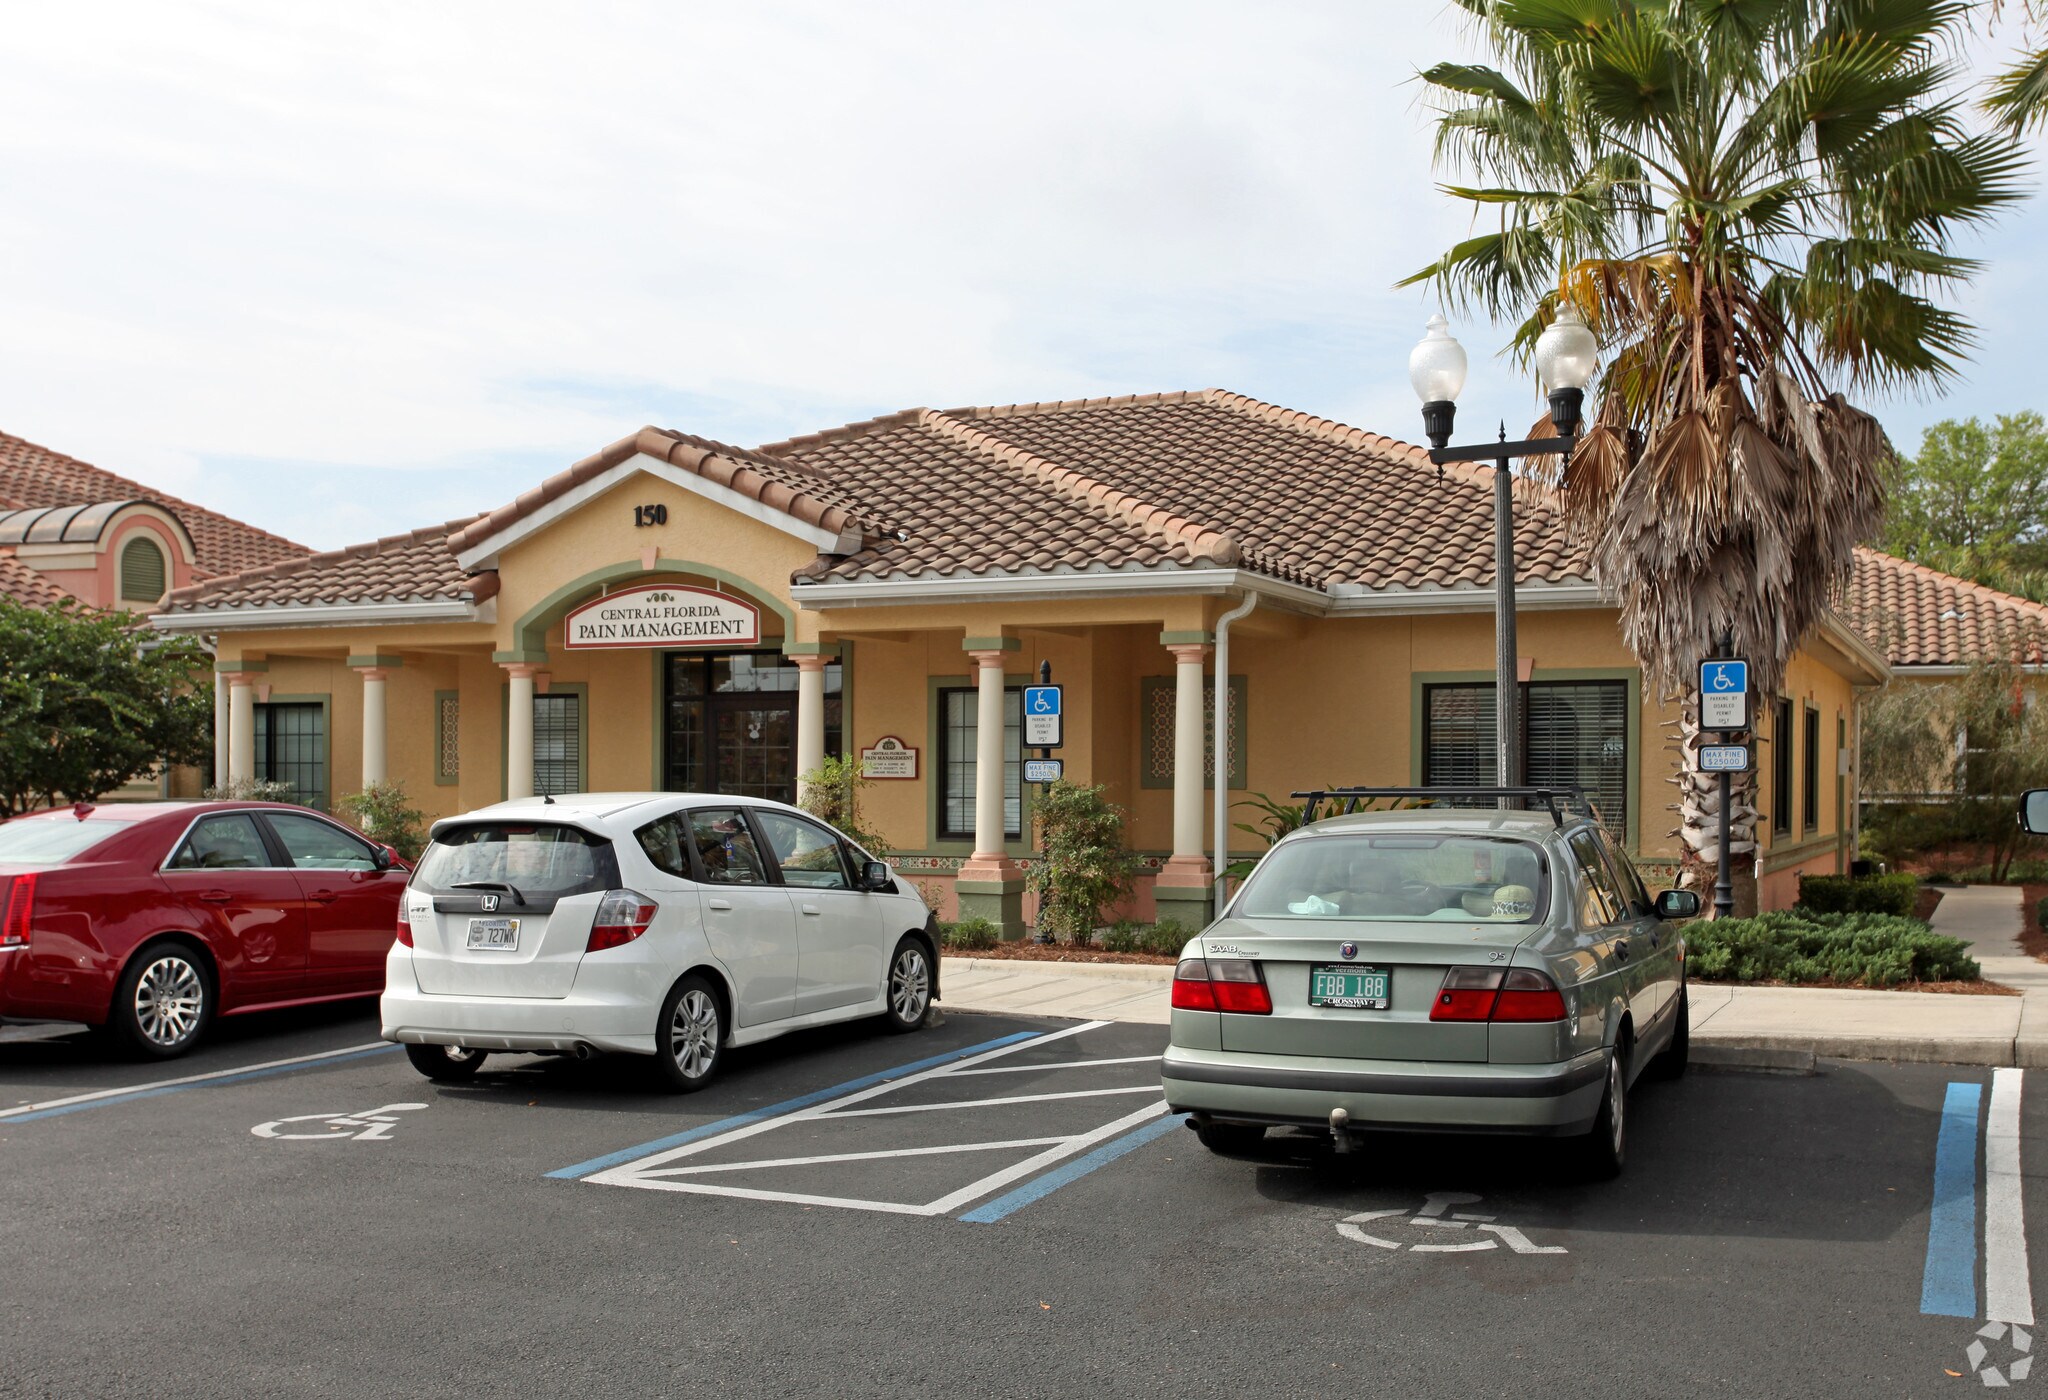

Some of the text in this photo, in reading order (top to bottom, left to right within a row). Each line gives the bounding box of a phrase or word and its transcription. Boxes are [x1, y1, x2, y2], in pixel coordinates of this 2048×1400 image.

[633, 504, 668, 527] 150
[600, 605, 721, 621] CENTRAL FLORIDA
[578, 619, 745, 640] PAIN MANAGEMENT
[488, 928, 516, 943] 727WK
[1209, 945, 1238, 953] SAAB
[1317, 976, 1384, 997] FBB 188
[1328, 998, 1370, 1006] CROSSWAY
